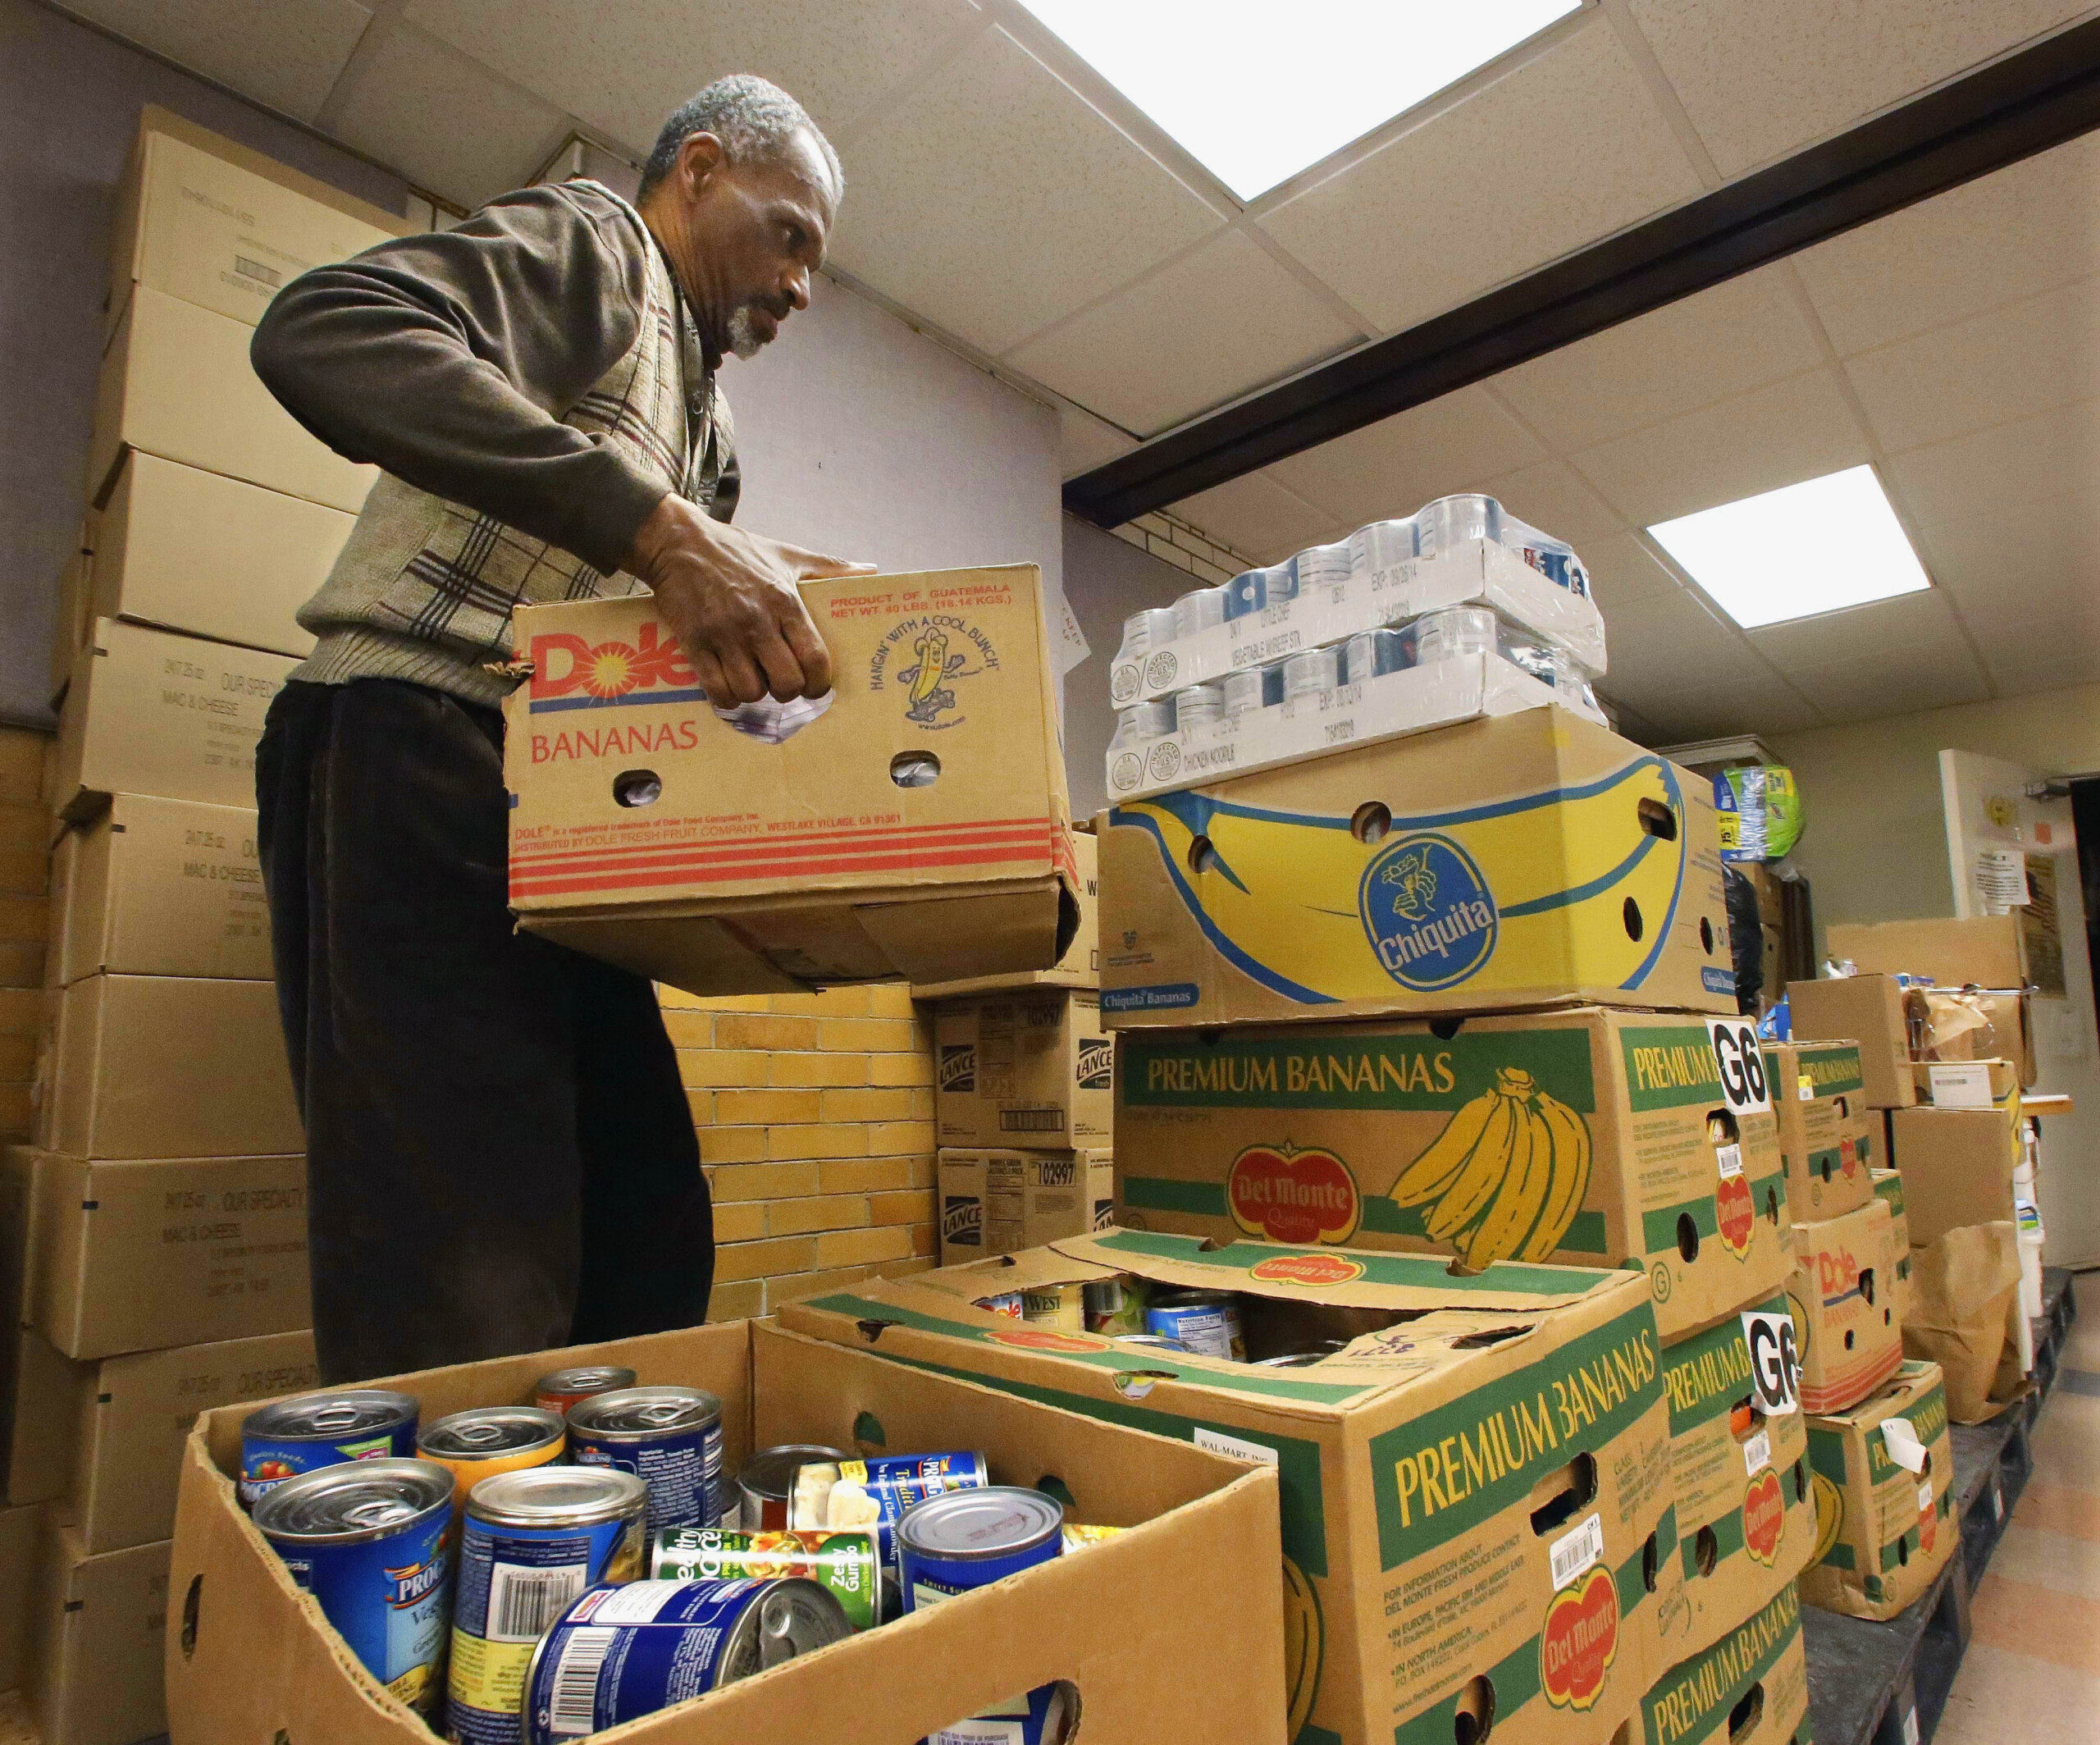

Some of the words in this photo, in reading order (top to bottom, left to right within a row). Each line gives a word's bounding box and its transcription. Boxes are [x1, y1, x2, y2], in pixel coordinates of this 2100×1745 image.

[830, 594, 893, 608] PRODUCT
[902, 591, 920, 601] OF
[929, 584, 1011, 598] GUATEMALA
[831, 610, 855, 619] NET
[885, 605, 900, 614] 40
[886, 619, 918, 642] WITH
[922, 616, 929, 626] A
[932, 614, 966, 633] COOL
[529, 623, 698, 700] Dole
[532, 720, 698, 764] BANANAS
[514, 839, 569, 853] DISTRIBUTED
[586, 835, 616, 846] DOLE
[621, 831, 660, 843] FRESH
[664, 827, 697, 838] FRUIT
[767, 820, 815, 831] WESTLAKE
[1377, 898, 1493, 972] Chiquita
[1104, 990, 1145, 1010] Chiquita
[1148, 991, 1191, 1004] Bananas
[940, 1053, 975, 1085] LANCE
[1076, 1049, 1112, 1081] LANCE
[1148, 1054, 1278, 1093] PREMIUM
[1286, 1051, 1455, 1094] BANANAS
[1633, 1045, 1710, 1090] PREMIUM
[1714, 1024, 1766, 1106] G6
[1039, 1161, 1075, 1186] 102997
[1238, 1175, 1273, 1204] Del
[1276, 1176, 1349, 1210] Monte
[943, 1207, 983, 1236] LANCE
[1664, 1345, 1735, 1413] PREMIUM
[1201, 1439, 1248, 1459] WAL-MART
[1395, 1392, 1558, 1529] PREMIUM
[1552, 1332, 1655, 1441] BANANAS
[667, 1528, 702, 1580] ealthy
[1384, 1586, 1401, 1602] FOR
[1404, 1560, 1458, 1593] INFORMATION
[1459, 1543, 1481, 1565] ABOUT
[1385, 1601, 1402, 1616] DEL
[1404, 1587, 1433, 1608] MONTE
[1435, 1574, 1458, 1593] FRESH
[1459, 1555, 1491, 1578] PRODUCE
[1547, 1630, 1573, 1670] Del
[1574, 1598, 1615, 1655] Monte
[1407, 1645, 1436, 1669] NORTH
[1654, 1640, 1742, 1745] PREMIUM
